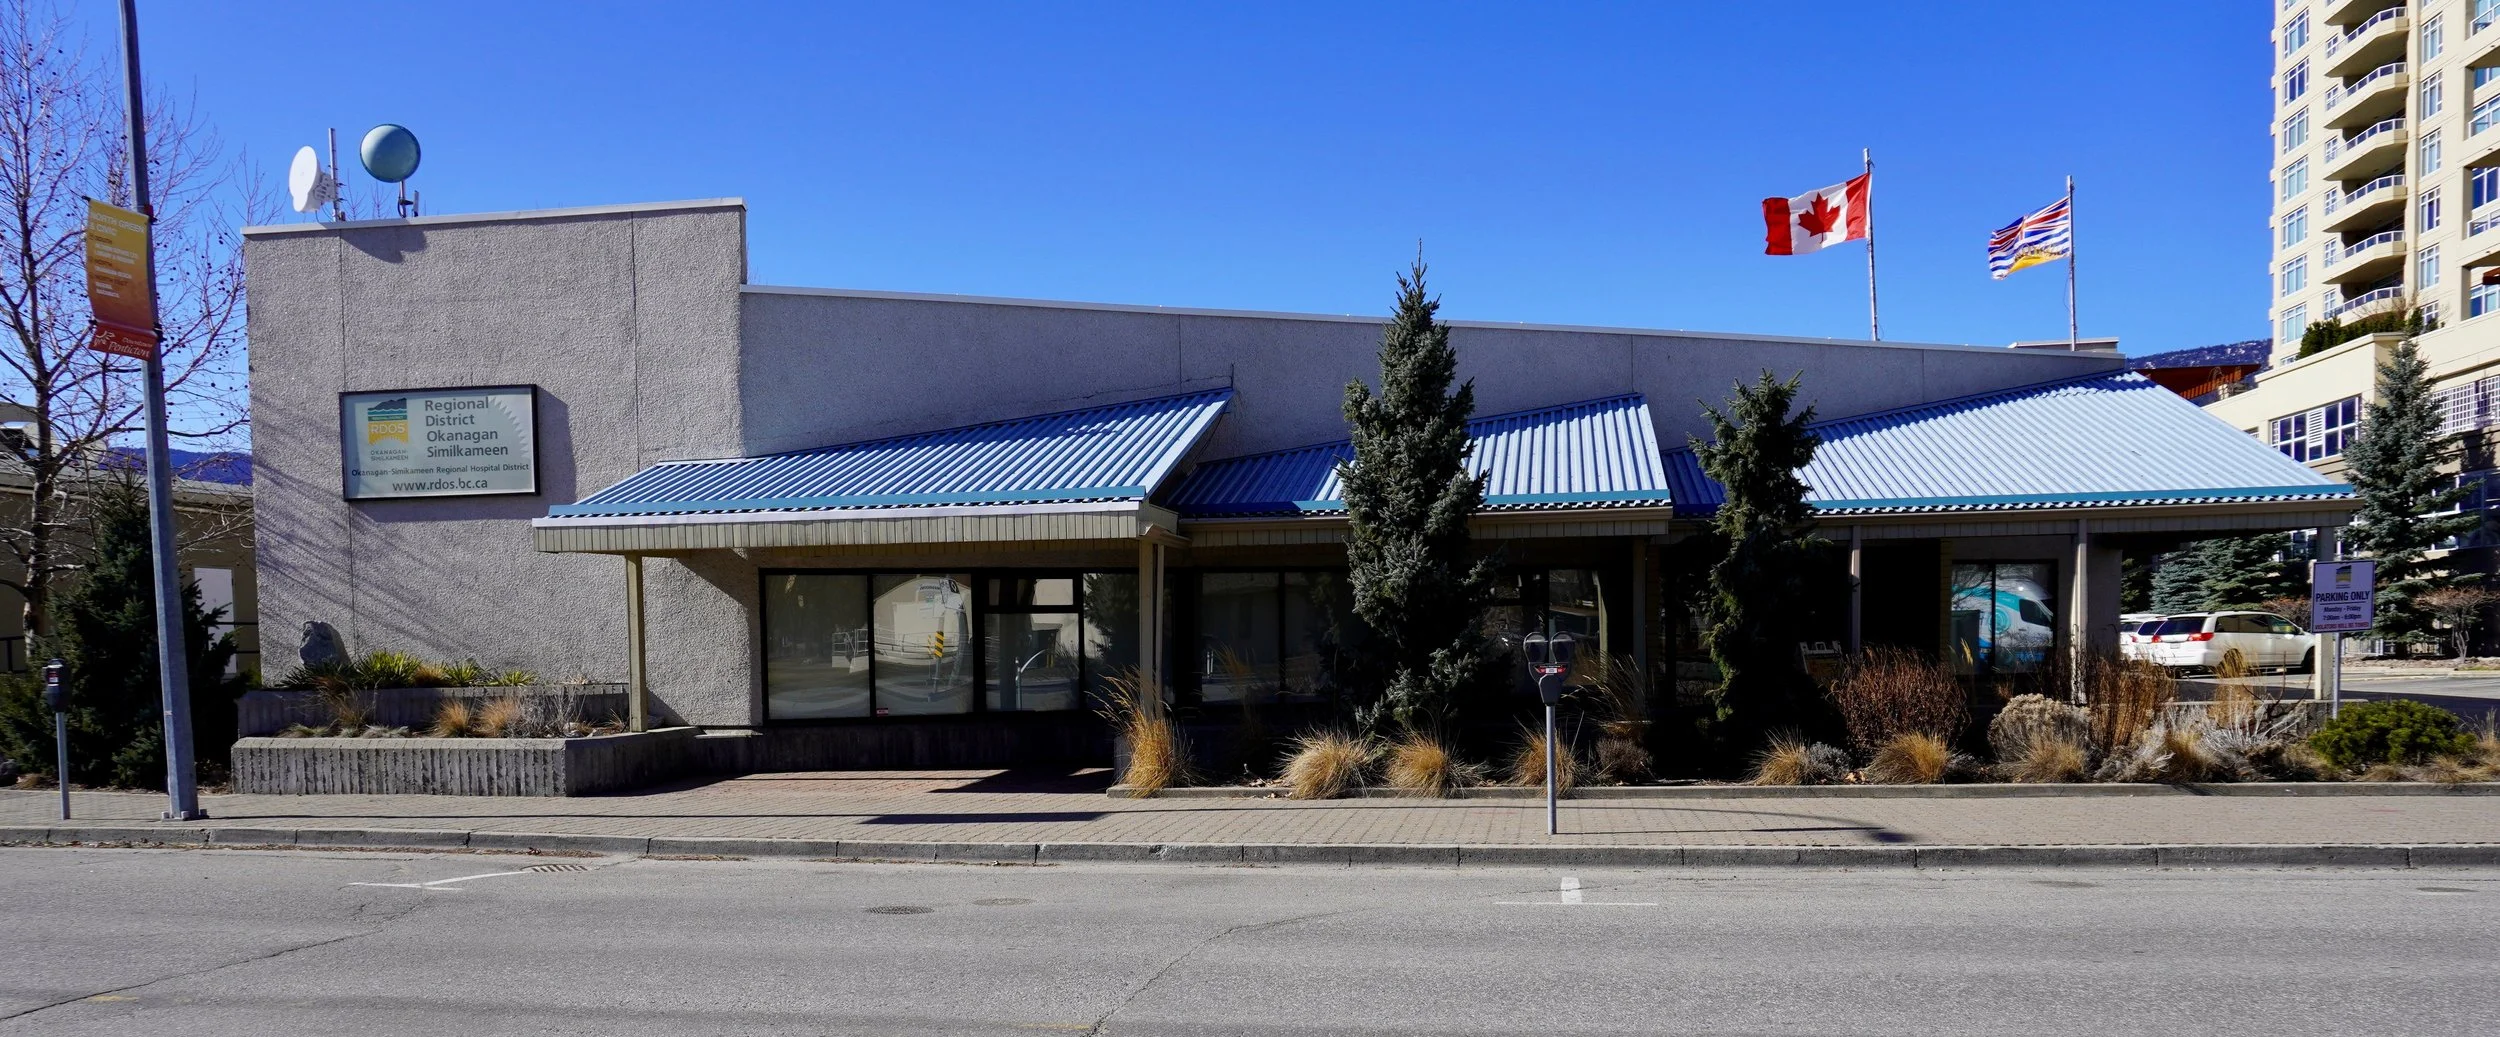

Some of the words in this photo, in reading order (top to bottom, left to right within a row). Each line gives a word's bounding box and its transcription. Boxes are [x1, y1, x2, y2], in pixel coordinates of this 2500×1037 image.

[108, 341, 151, 358] Penticton
[424, 396, 489, 414] Regional
[425, 413, 475, 427] District
[371, 423, 406, 434] RDOS
[426, 430, 498, 443] Okanagan
[427, 444, 509, 458] Similkameen
[436, 465, 468, 475] Regional
[470, 464, 501, 473] Hospital
[502, 463, 529, 471] District
[392, 478, 488, 491] www.rdos.bc.ca
[2315, 592, 2349, 602] PARKING
[2350, 591, 2371, 601] ONLY
